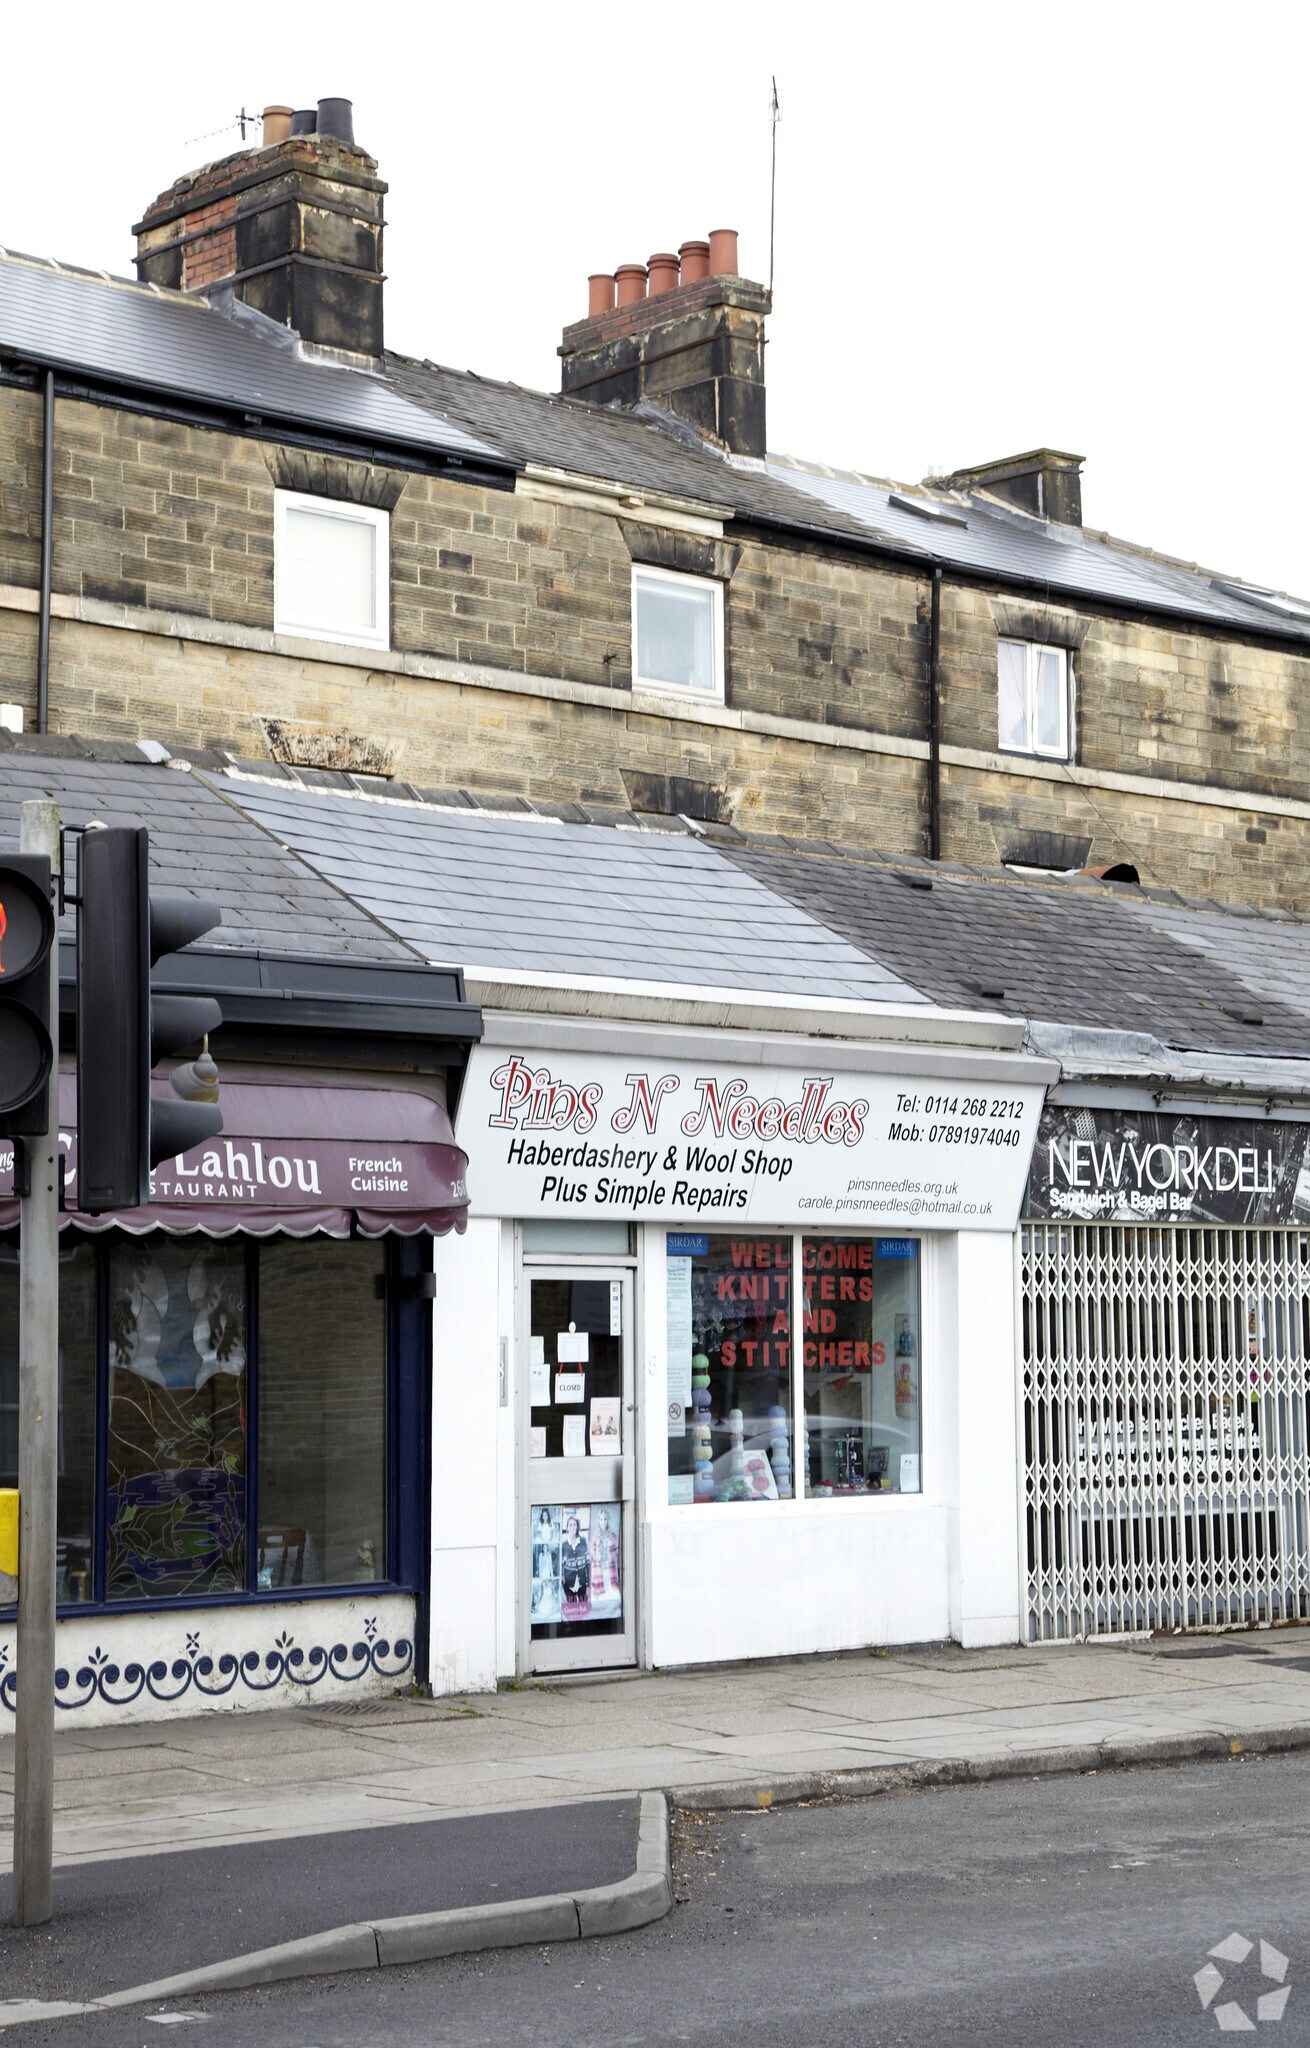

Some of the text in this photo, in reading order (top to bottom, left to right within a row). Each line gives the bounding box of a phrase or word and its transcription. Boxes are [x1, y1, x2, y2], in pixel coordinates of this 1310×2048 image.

[489, 1056, 870, 1147] Pins N Needles
[896, 1094, 1024, 1119] Tel: 0114 268 2212
[888, 1122, 1021, 1147] Mob: 07891974040
[175, 1141, 323, 1194] Lahlou
[348, 1157, 403, 1173] French
[507, 1138, 793, 1182] Haberdashery & Wool Shop
[350, 1176, 409, 1192] Cuisine
[540, 1175, 749, 1213] Plus Simple Repairs
[847, 1177, 959, 1198] pinsnneedles.org.uk
[797, 1195, 994, 1216] carole.pinsnneedles@hotmail.co.uk
[1049, 1187, 1193, 1213] Sandwich & Bagel Bar
[669, 1236, 703, 1248] SIRDAR
[881, 1241, 912, 1251] SIRDAR
[730, 1242, 873, 1270] WELCOME
[717, 1275, 874, 1301] KNITTERS
[772, 1308, 837, 1334] AND
[720, 1340, 887, 1367] STITCHERS
[559, 1384, 581, 1392] CLOSED
